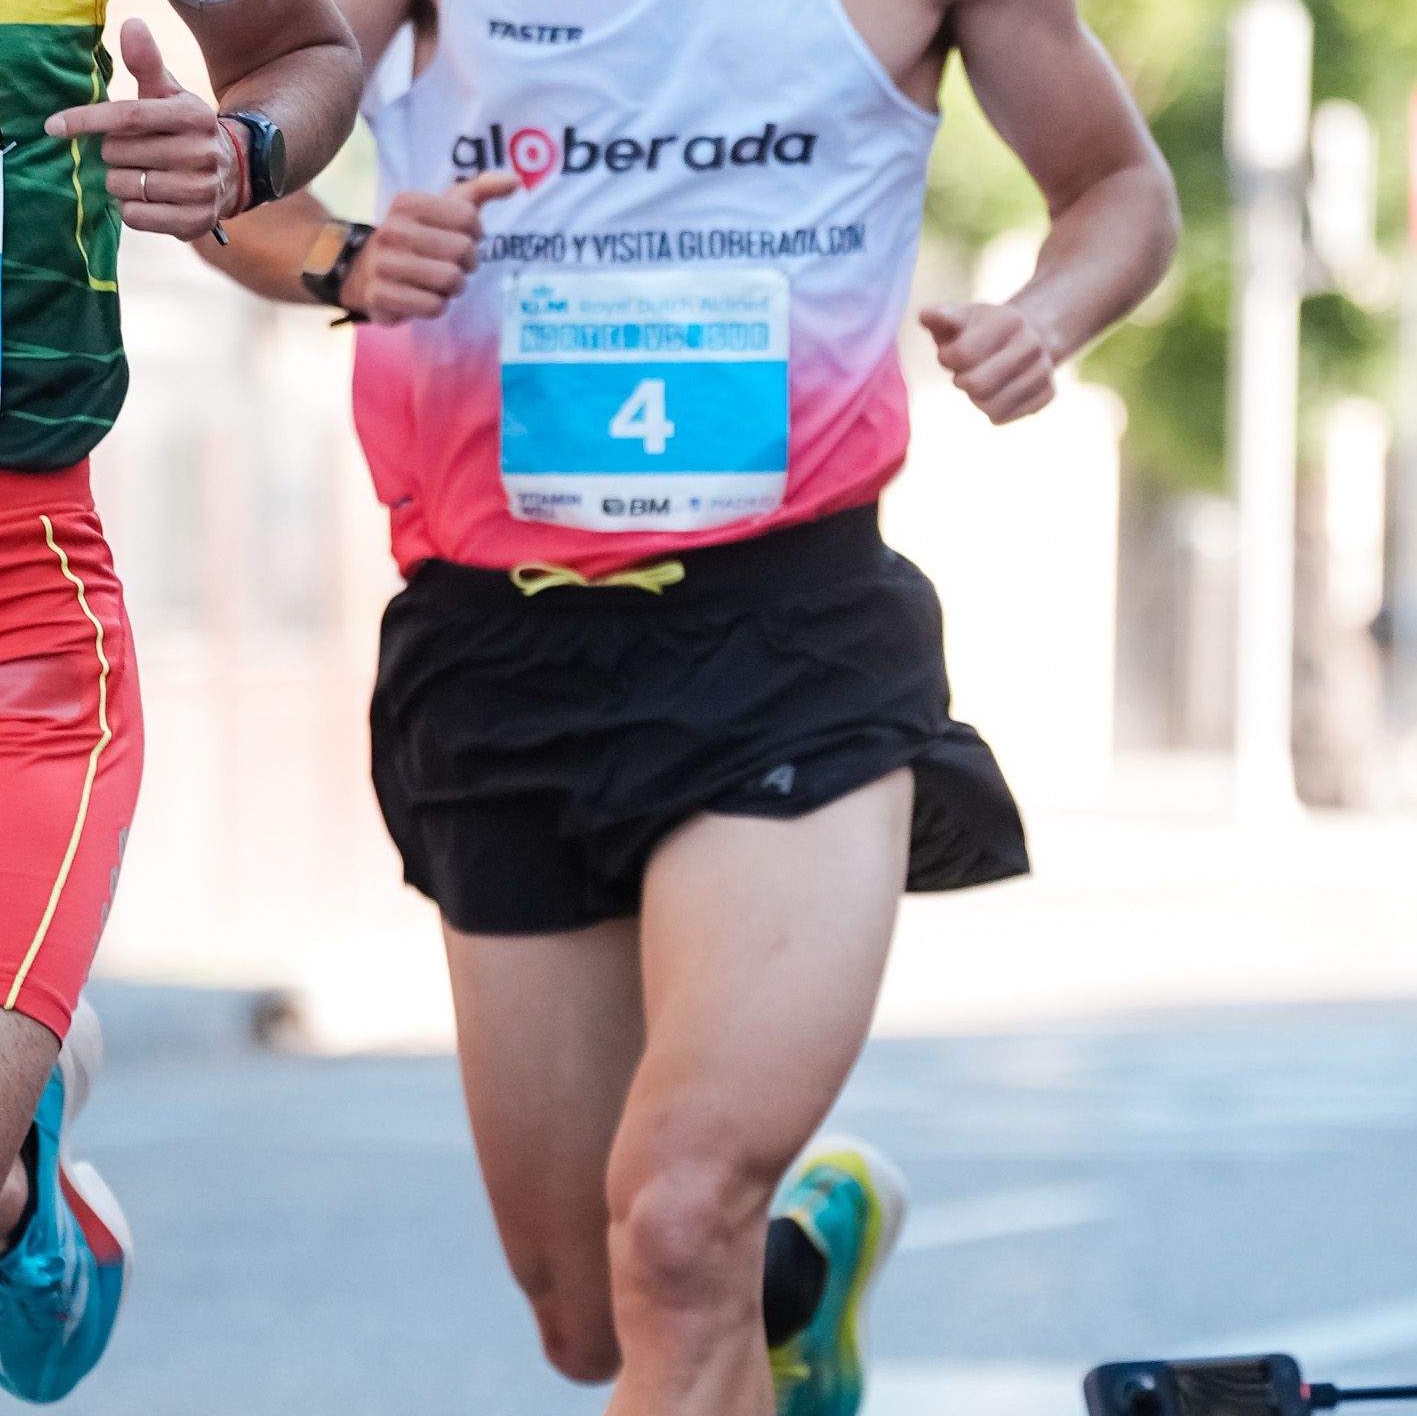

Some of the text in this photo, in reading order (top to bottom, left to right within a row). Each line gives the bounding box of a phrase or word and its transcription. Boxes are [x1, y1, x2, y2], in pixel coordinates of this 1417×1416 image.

[452, 123, 819, 190] globerada
[592, 232, 671, 262] VISITA
[610, 378, 675, 455] 4
